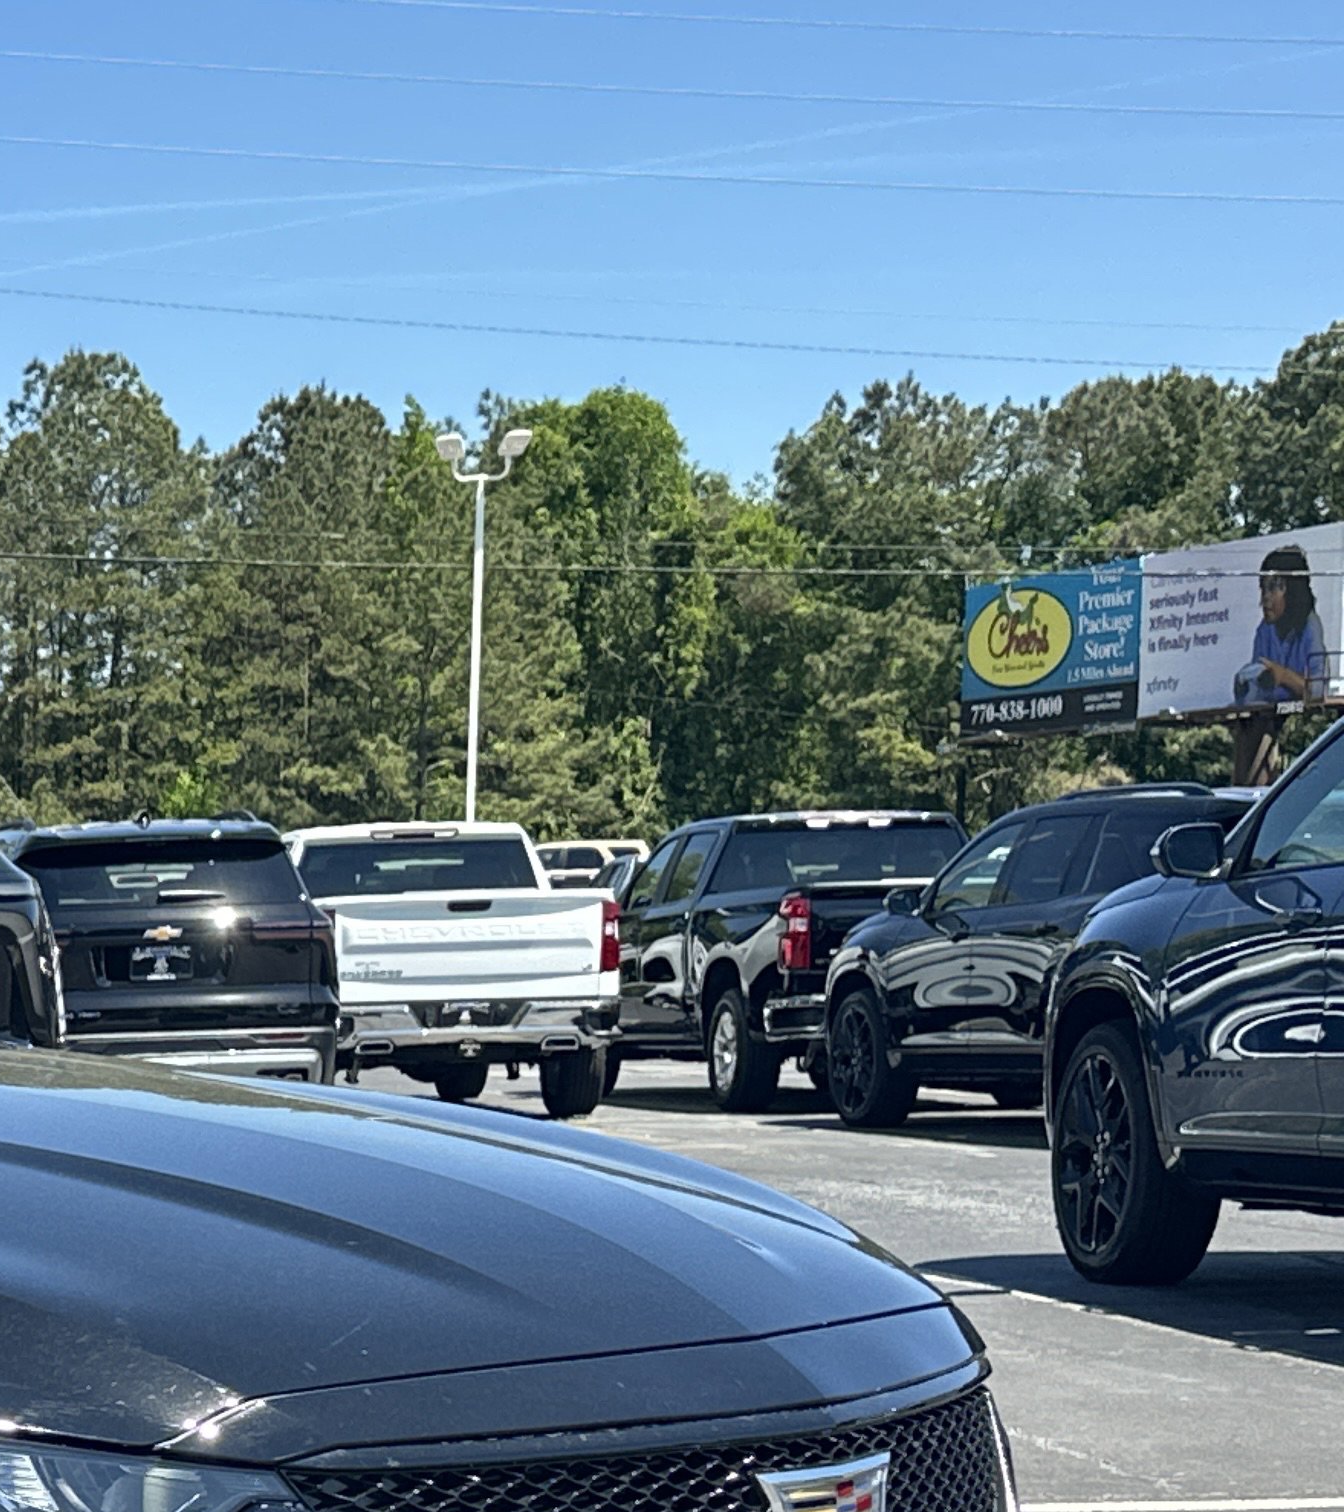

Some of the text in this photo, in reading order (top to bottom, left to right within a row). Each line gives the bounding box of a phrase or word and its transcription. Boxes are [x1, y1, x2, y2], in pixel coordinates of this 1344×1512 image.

[1078, 587, 1135, 613] Premier
[1149, 587, 1219, 611] seriously fast
[1078, 613, 1134, 637] Package
[1149, 608, 1229, 632] Xfinity Internet
[1083, 636, 1126, 662] Store!
[1147, 631, 1219, 654] is finally here
[1146, 675, 1180, 696] xfinity
[971, 695, 1062, 725] 770-838-1000
